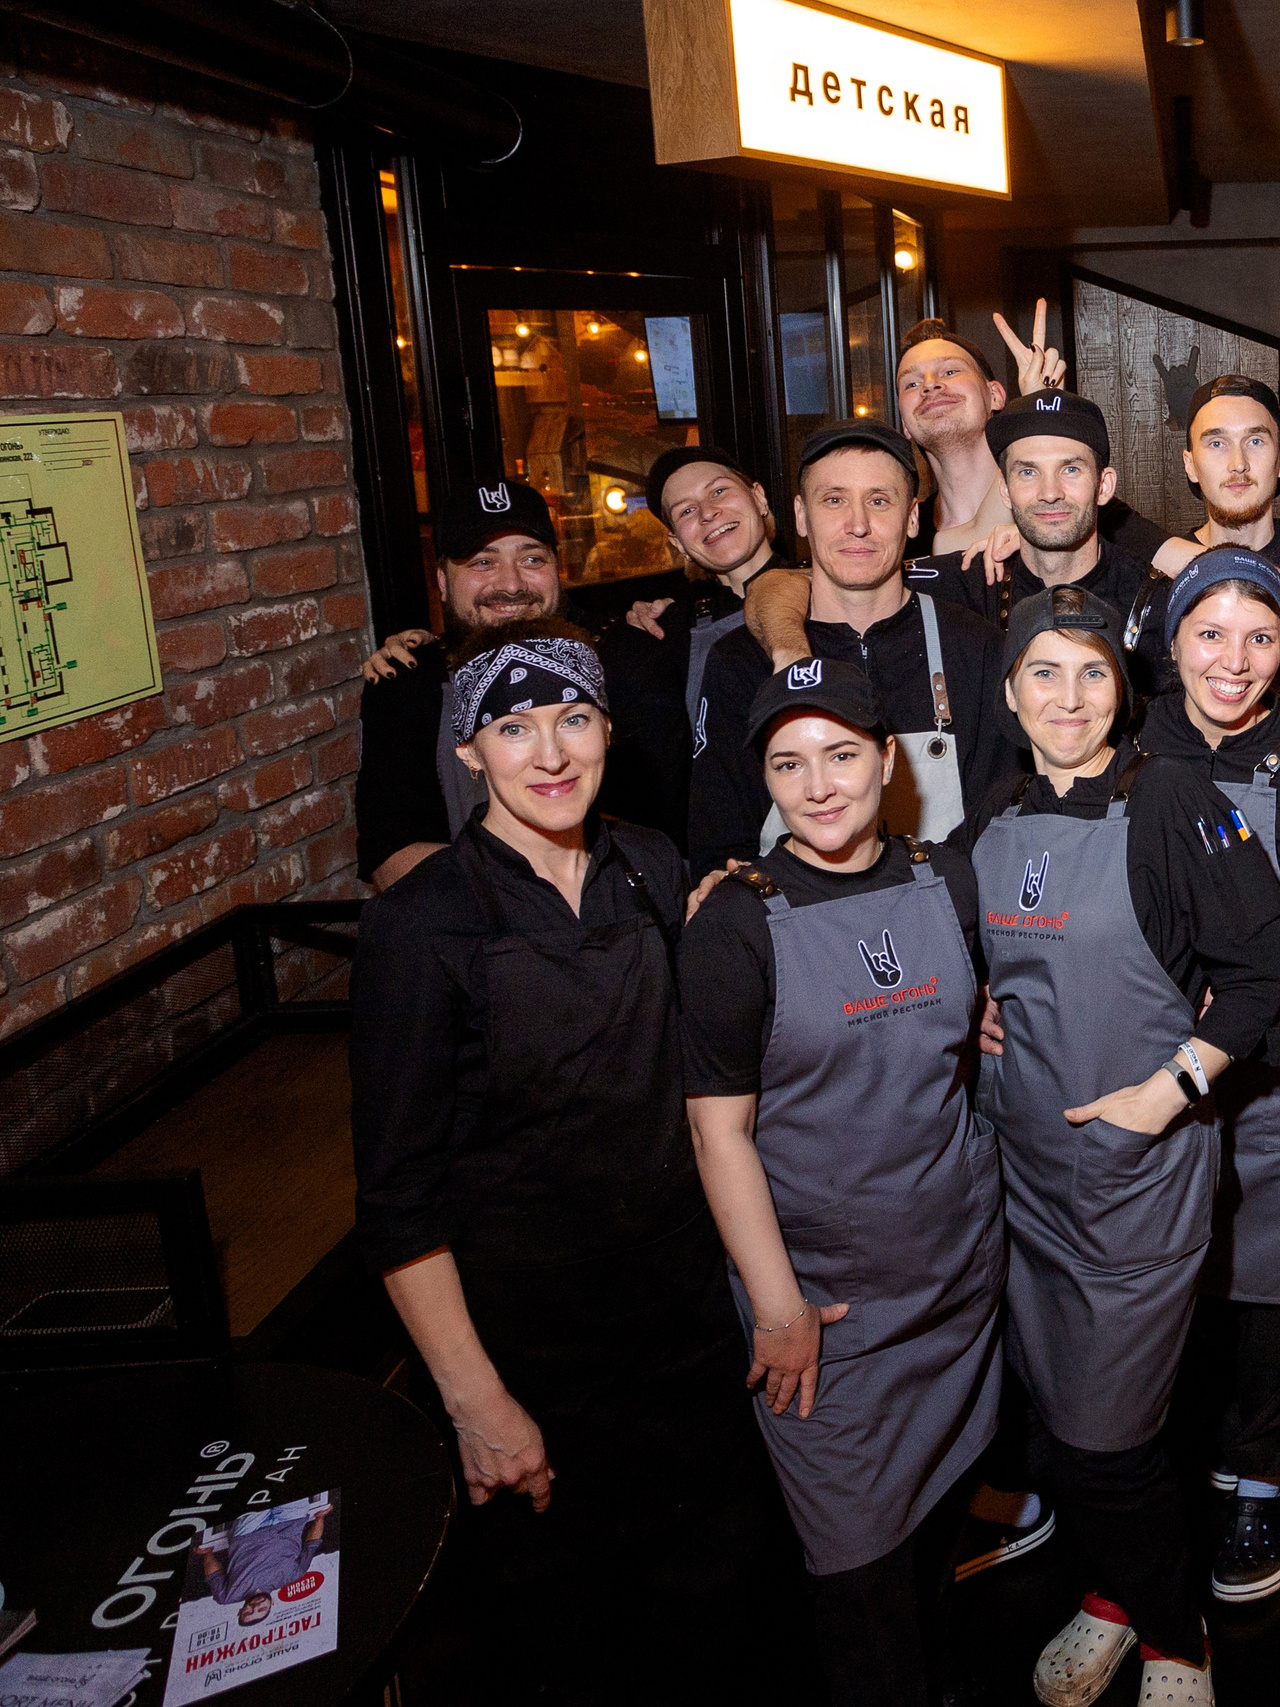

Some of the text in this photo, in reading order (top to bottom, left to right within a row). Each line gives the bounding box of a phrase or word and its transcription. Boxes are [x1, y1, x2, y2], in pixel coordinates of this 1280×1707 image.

[789, 62, 970, 134] детская
[986, 911, 1020, 927] ВАШЕ
[1018, 931, 1065, 942] РЕСТОРАН
[843, 994, 889, 1015] ВАШЕ
[847, 998, 942, 1028] МЯСНОЙ РЕСТОРАН
[287, 1581, 316, 1598] НОВЫЙ
[185, 1612, 322, 1674] ГАСТРОУЖИН
